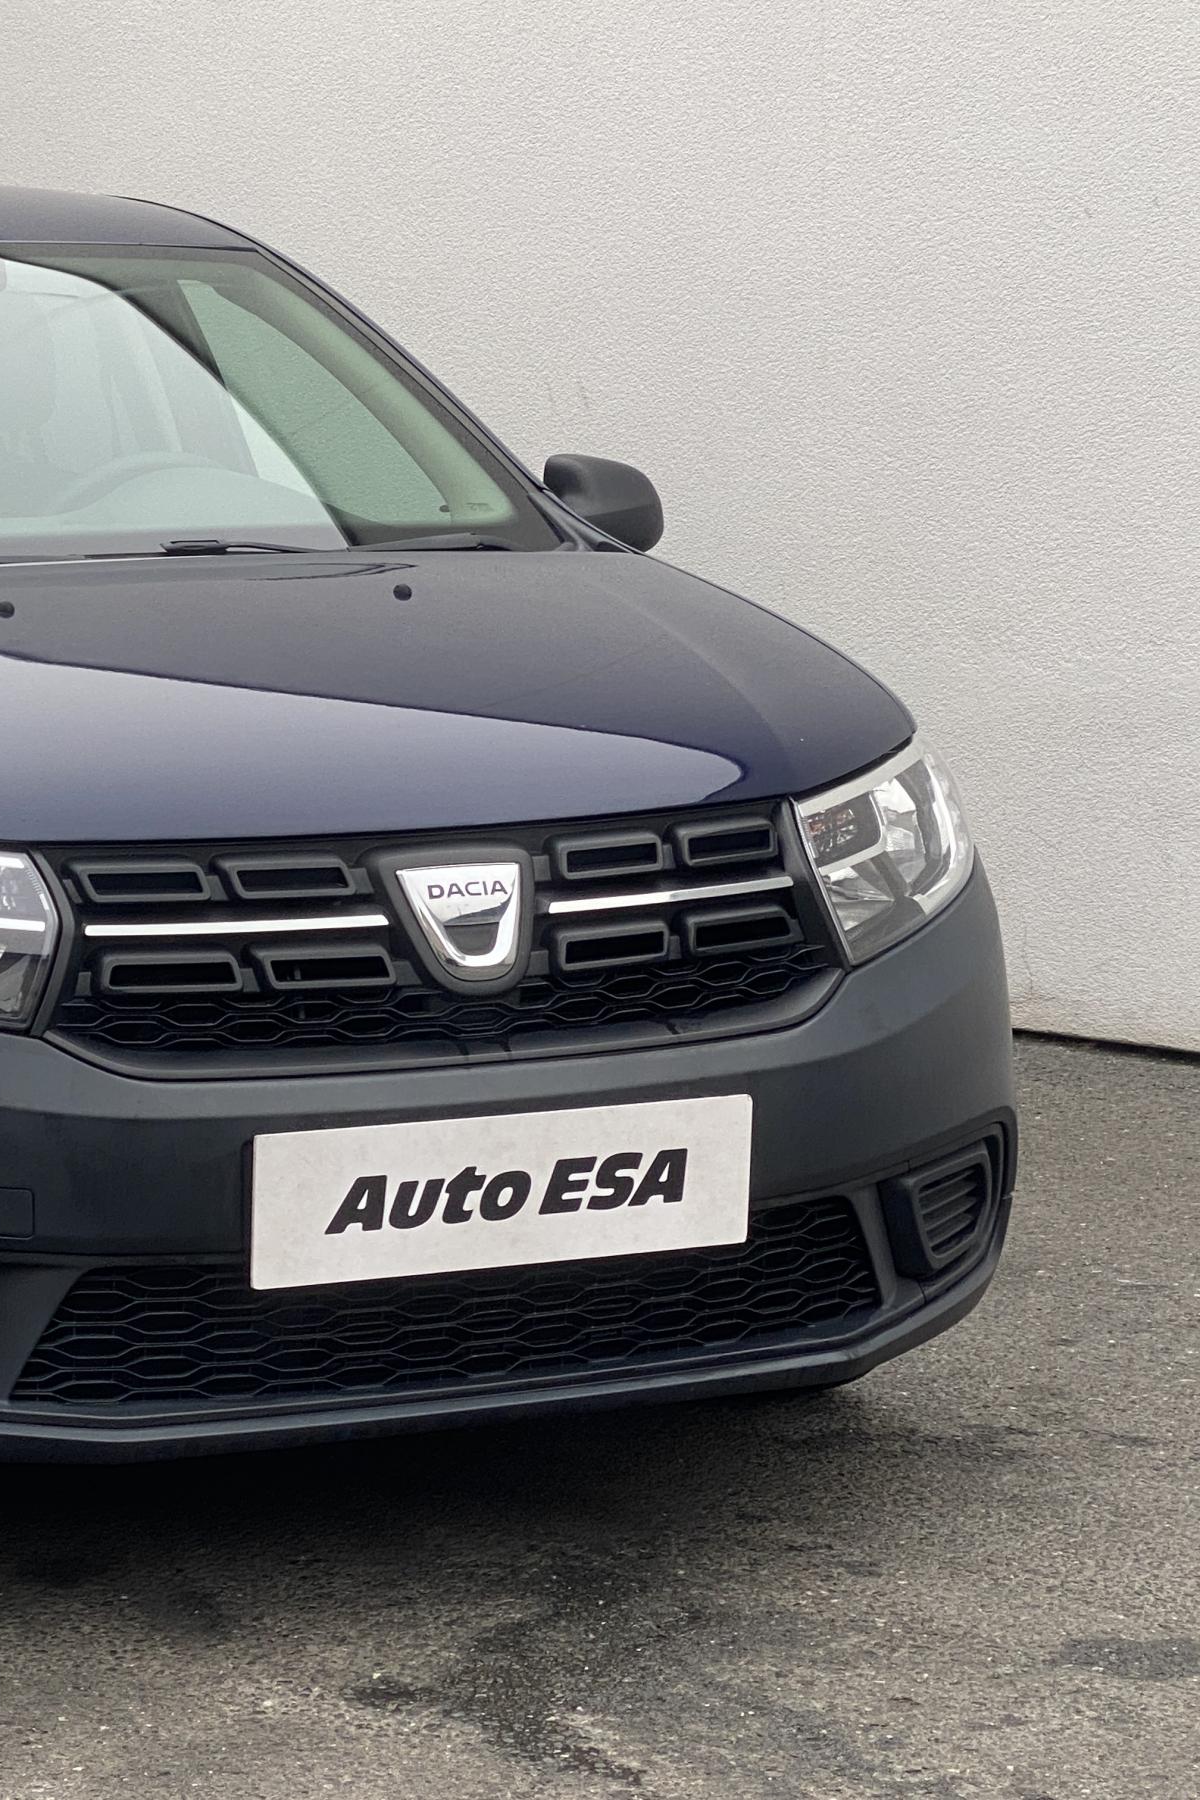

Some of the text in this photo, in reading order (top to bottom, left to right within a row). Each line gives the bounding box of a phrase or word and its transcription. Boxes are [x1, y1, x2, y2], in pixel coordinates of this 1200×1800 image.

[427, 880, 508, 900] DACIA
[324, 1148, 688, 1235] Auto ESA
